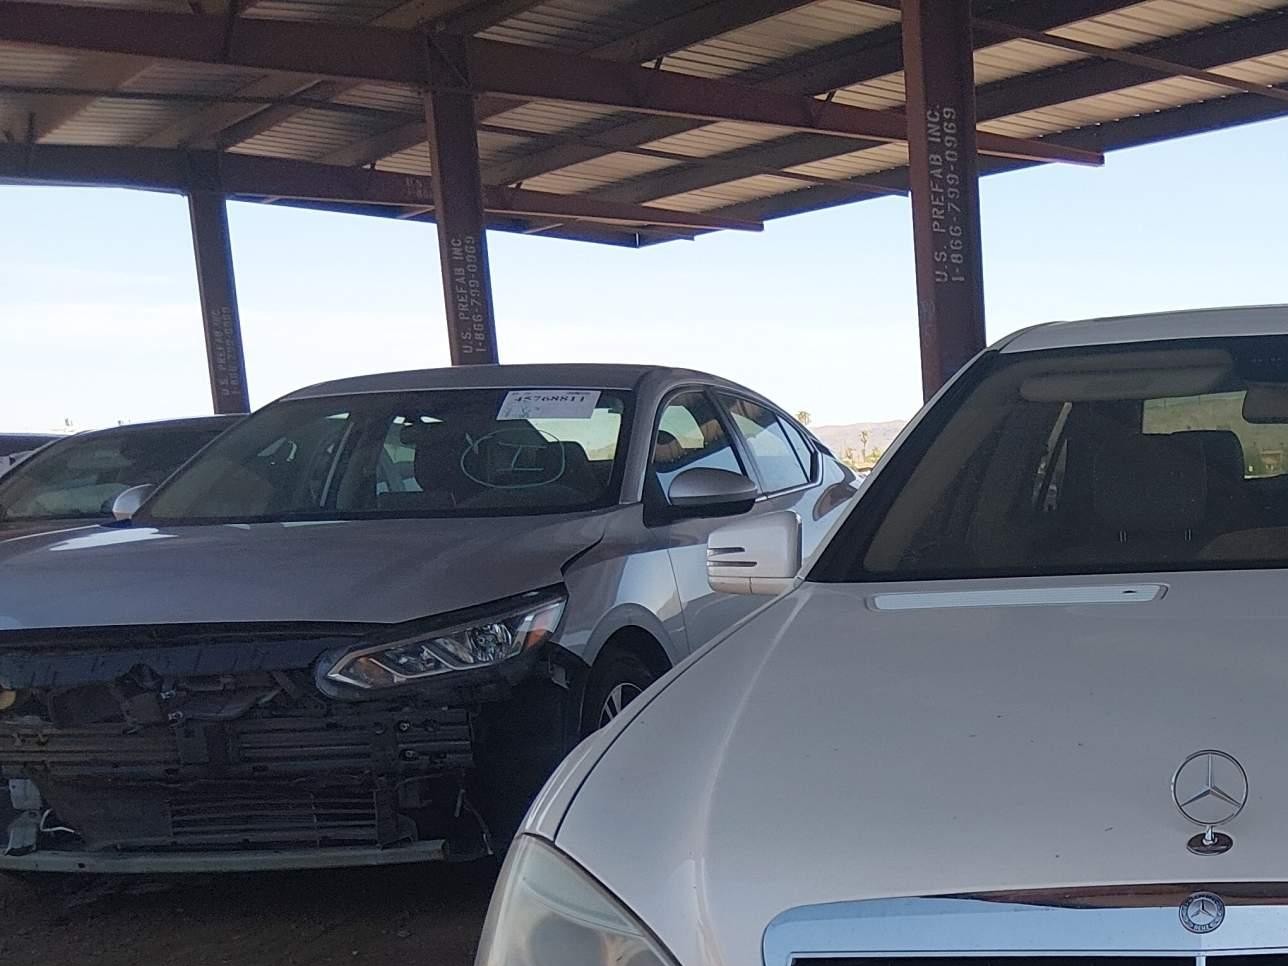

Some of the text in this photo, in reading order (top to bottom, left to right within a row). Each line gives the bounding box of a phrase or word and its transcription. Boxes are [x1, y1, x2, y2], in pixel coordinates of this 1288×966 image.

[927, 105, 948, 282] U.S. PREFAB INC.
[943, 107, 965, 282] 1-866-799-0969
[454, 267, 471, 320] PREFAB
